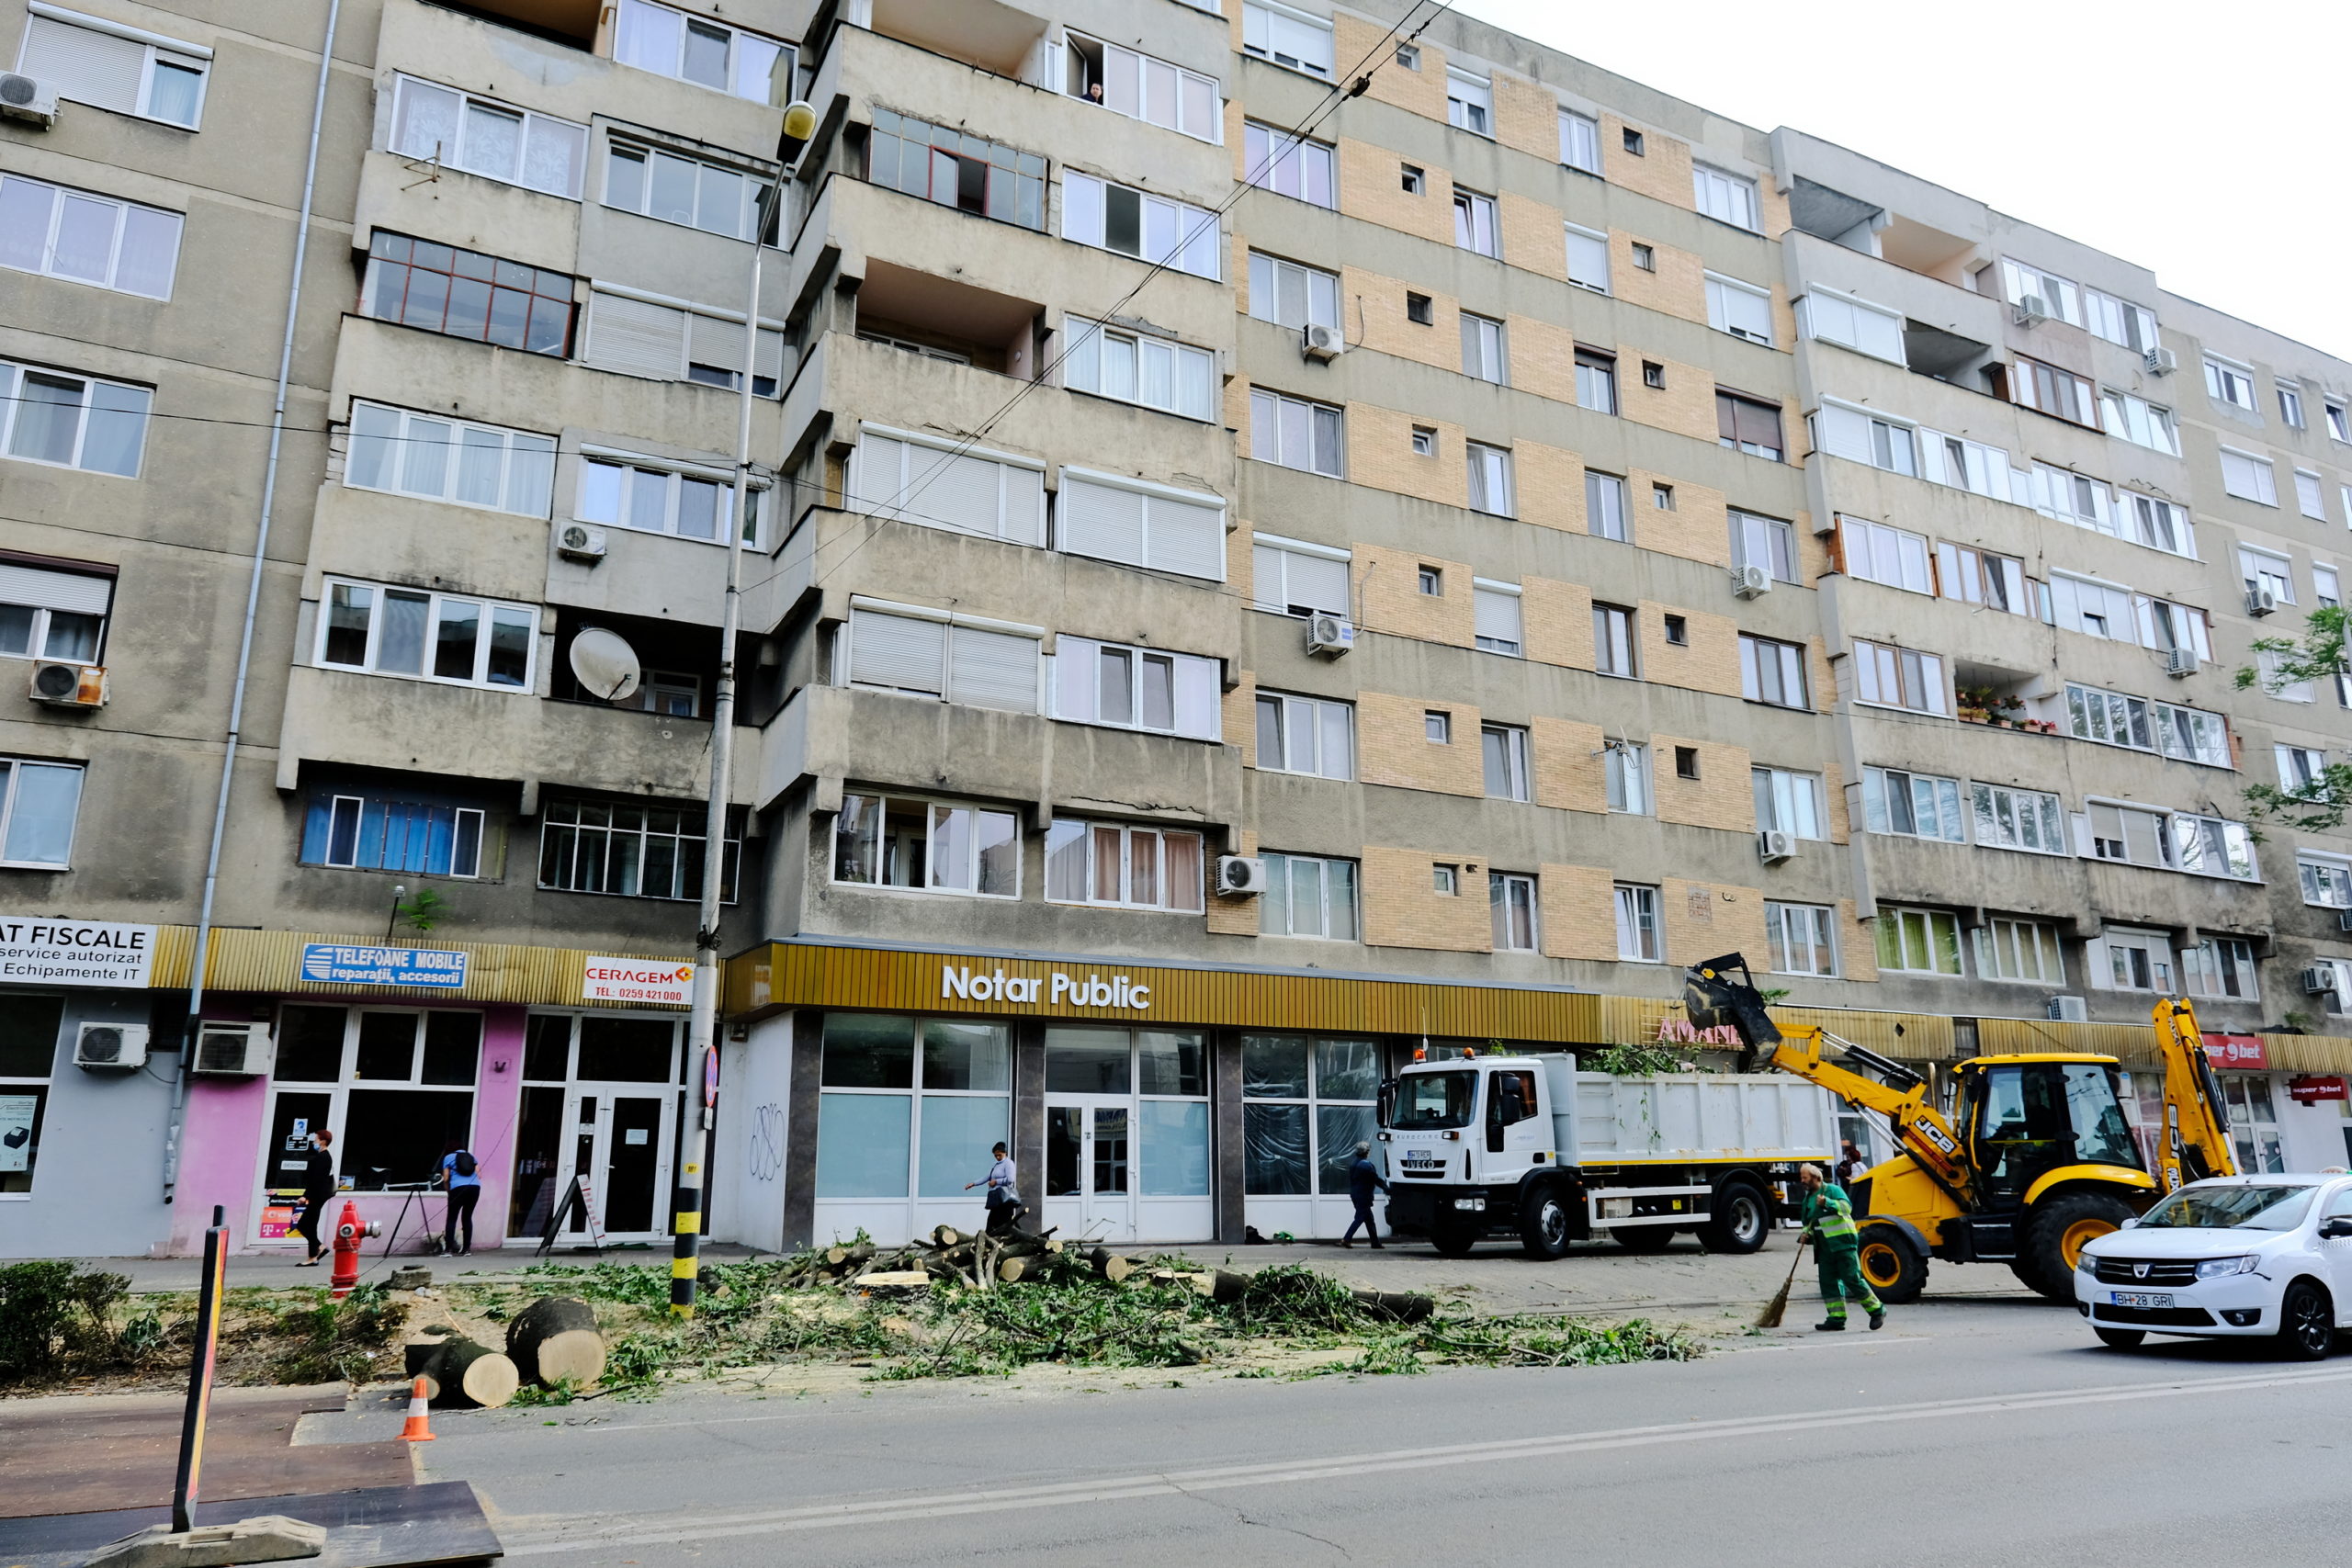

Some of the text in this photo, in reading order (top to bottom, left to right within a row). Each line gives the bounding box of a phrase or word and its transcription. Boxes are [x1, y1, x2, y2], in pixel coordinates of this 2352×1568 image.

[30, 926, 146, 950] FISCALE
[0, 947, 142, 964] service autorizat
[334, 947, 463, 970] TELEFOANE MOBILE
[4, 963, 140, 980] Echipamente IT
[399, 971, 459, 984] accesorii
[586, 967, 673, 984] CERAGEM
[619, 987, 643, 998] 0259
[646, 990, 662, 999] 421
[663, 991, 682, 1001] 000
[942, 965, 1150, 1010] Notar Public
[1915, 1119, 1955, 1154] JCB
[1407, 1159, 1435, 1169] IVECO
[2117, 1293, 2172, 1307] BH 28 GRI
